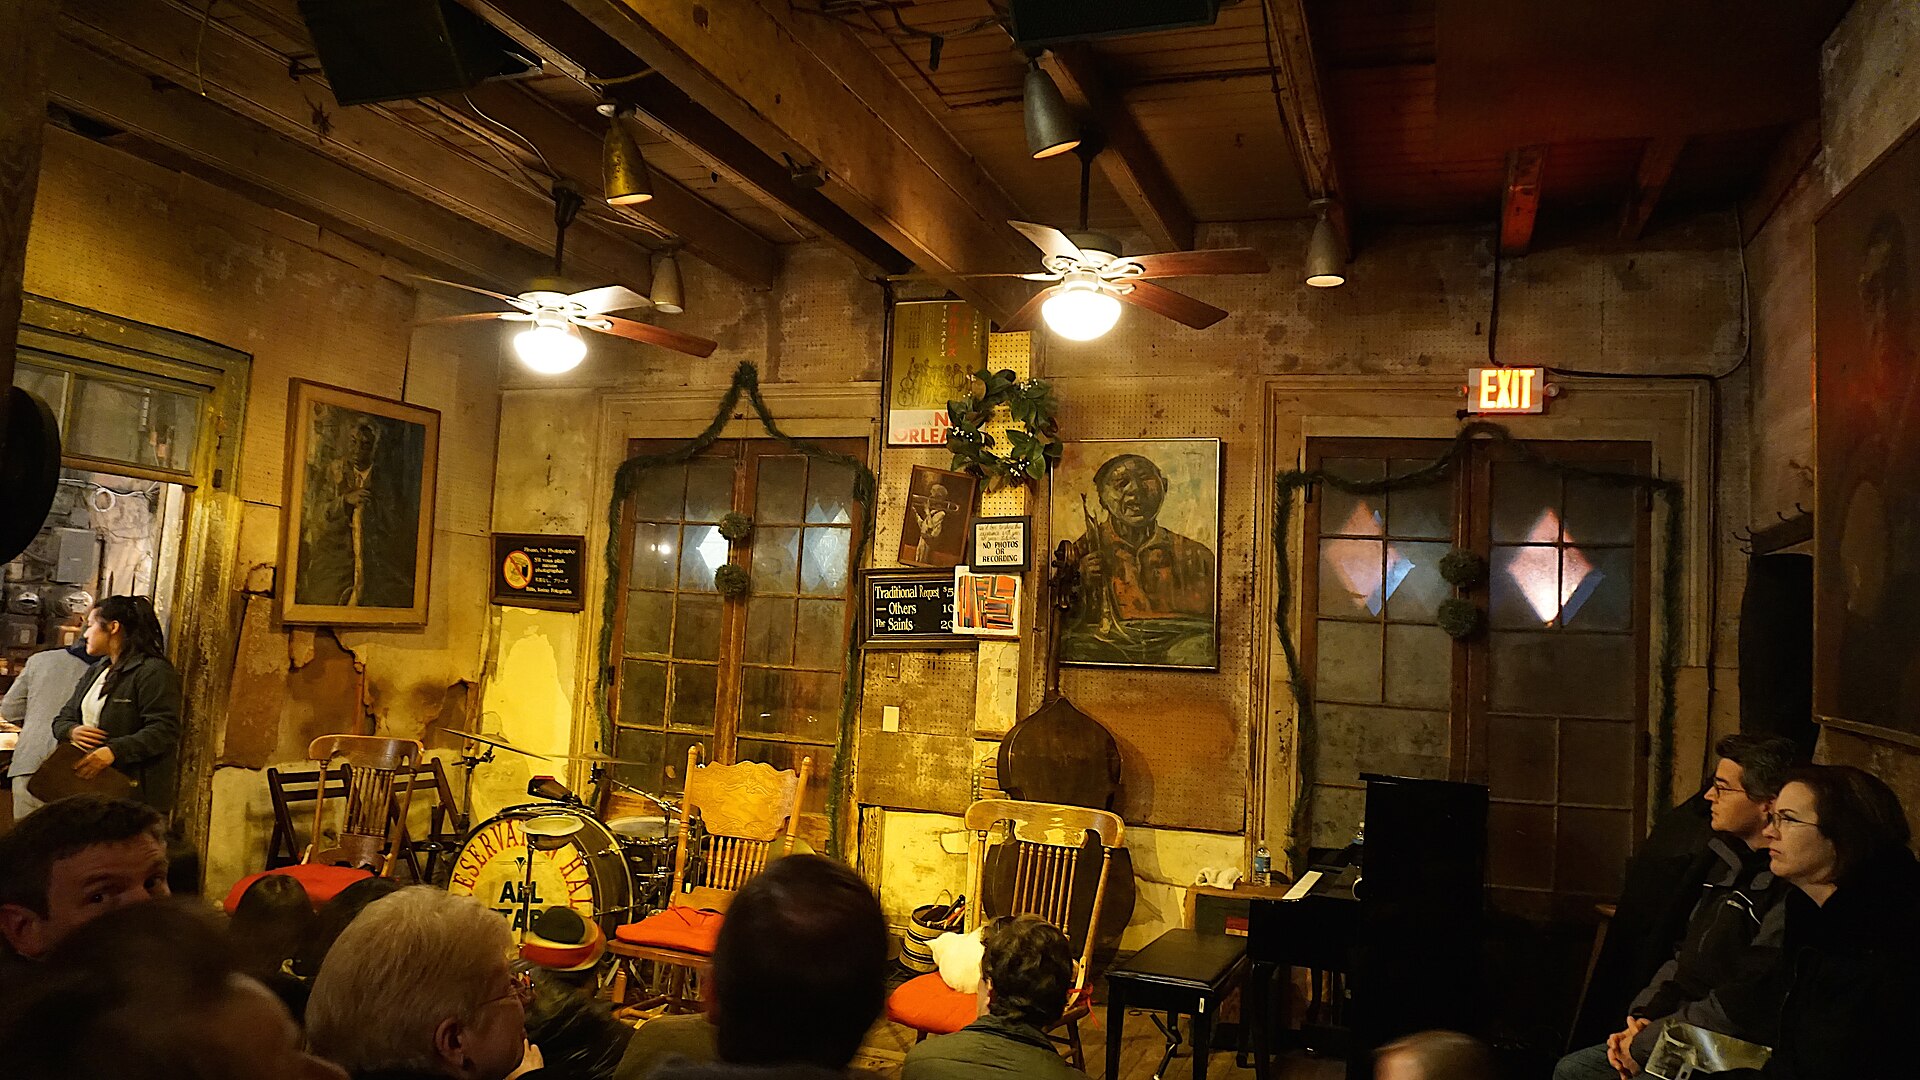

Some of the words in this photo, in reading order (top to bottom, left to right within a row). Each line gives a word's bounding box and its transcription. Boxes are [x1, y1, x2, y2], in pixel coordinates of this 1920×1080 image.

[1480, 369, 1536, 409] EXIT
[893, 428, 948, 444] ORLEA
[982, 541, 992, 550] NO
[994, 540, 1019, 549] PHOTOS
[982, 554, 1018, 563] RECORDING
[875, 584, 918, 599] Traditional
[919, 585, 940, 600] Request
[889, 602, 917, 615] Others
[875, 618, 886, 628] The
[887, 618, 914, 631] Saints
[499, 881, 544, 903] ALL
[559, 854, 593, 920] HAL
